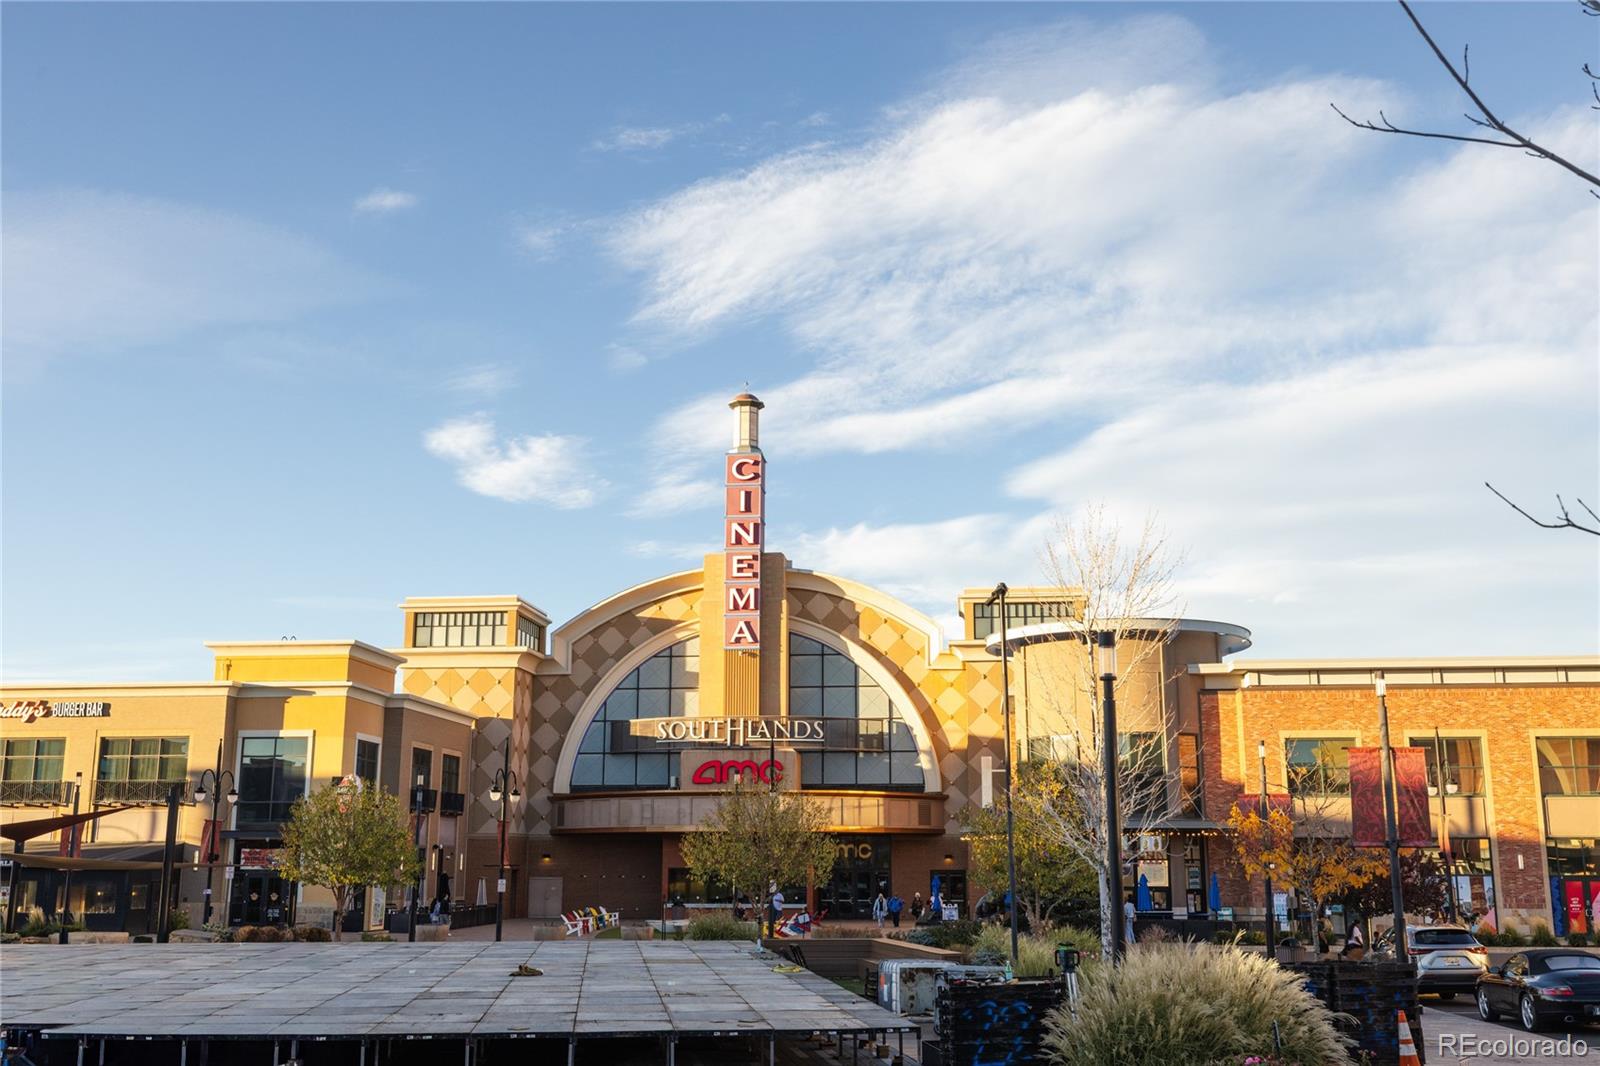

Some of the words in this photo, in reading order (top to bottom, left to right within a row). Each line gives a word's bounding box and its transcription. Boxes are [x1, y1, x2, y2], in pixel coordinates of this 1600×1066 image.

[729, 457, 761, 645] CINEMA
[0, 700, 48, 722] ddy's
[52, 702, 85, 717] BURGER
[86, 702, 104, 717] BAR
[656, 717, 825, 747] SOUTHLANDS
[692, 759, 785, 785] amc
